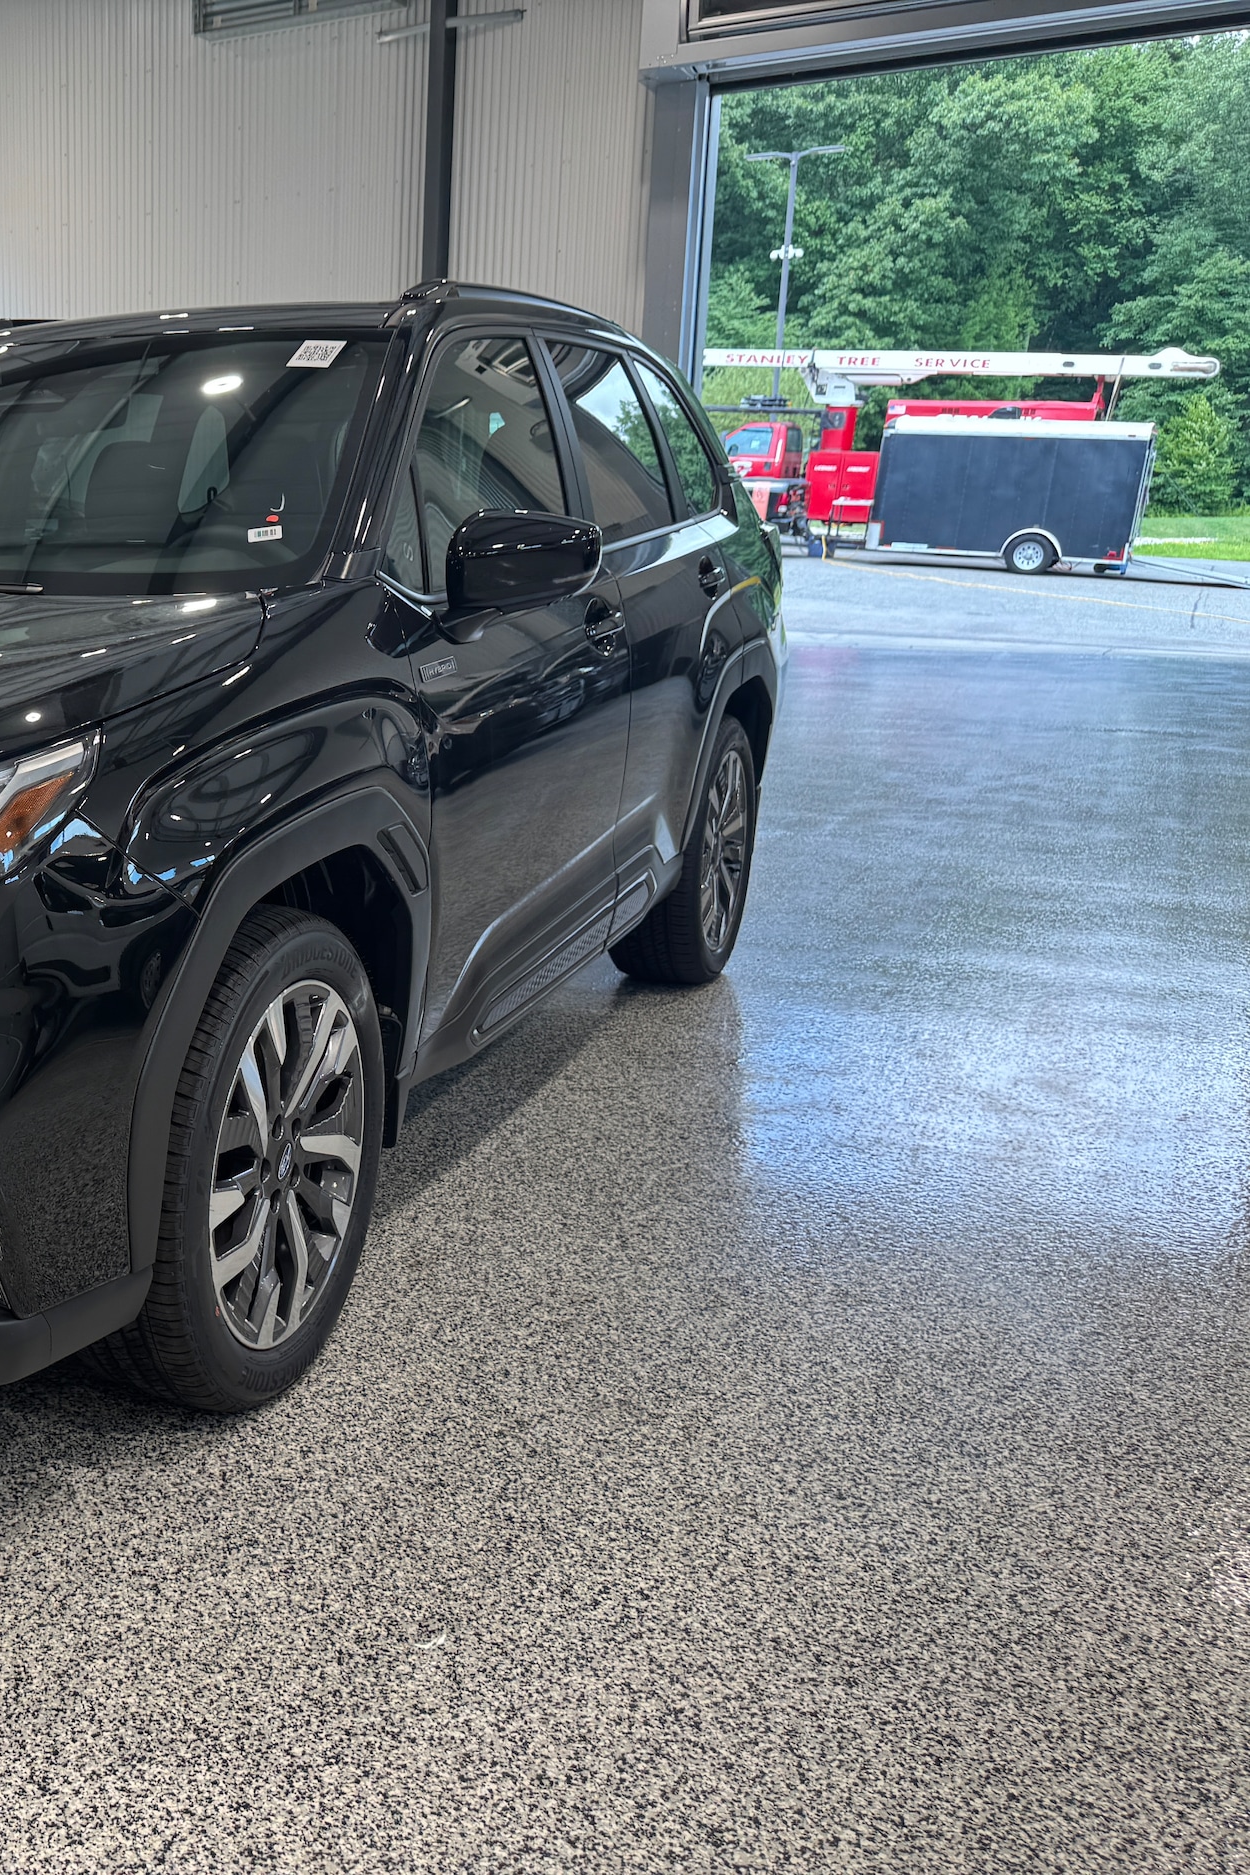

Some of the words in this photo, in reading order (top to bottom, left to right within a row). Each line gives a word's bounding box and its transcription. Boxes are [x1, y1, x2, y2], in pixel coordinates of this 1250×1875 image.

[726, 353, 809, 365] STANLEY
[837, 355, 881, 367] TREE
[914, 357, 991, 369] SERVICE
